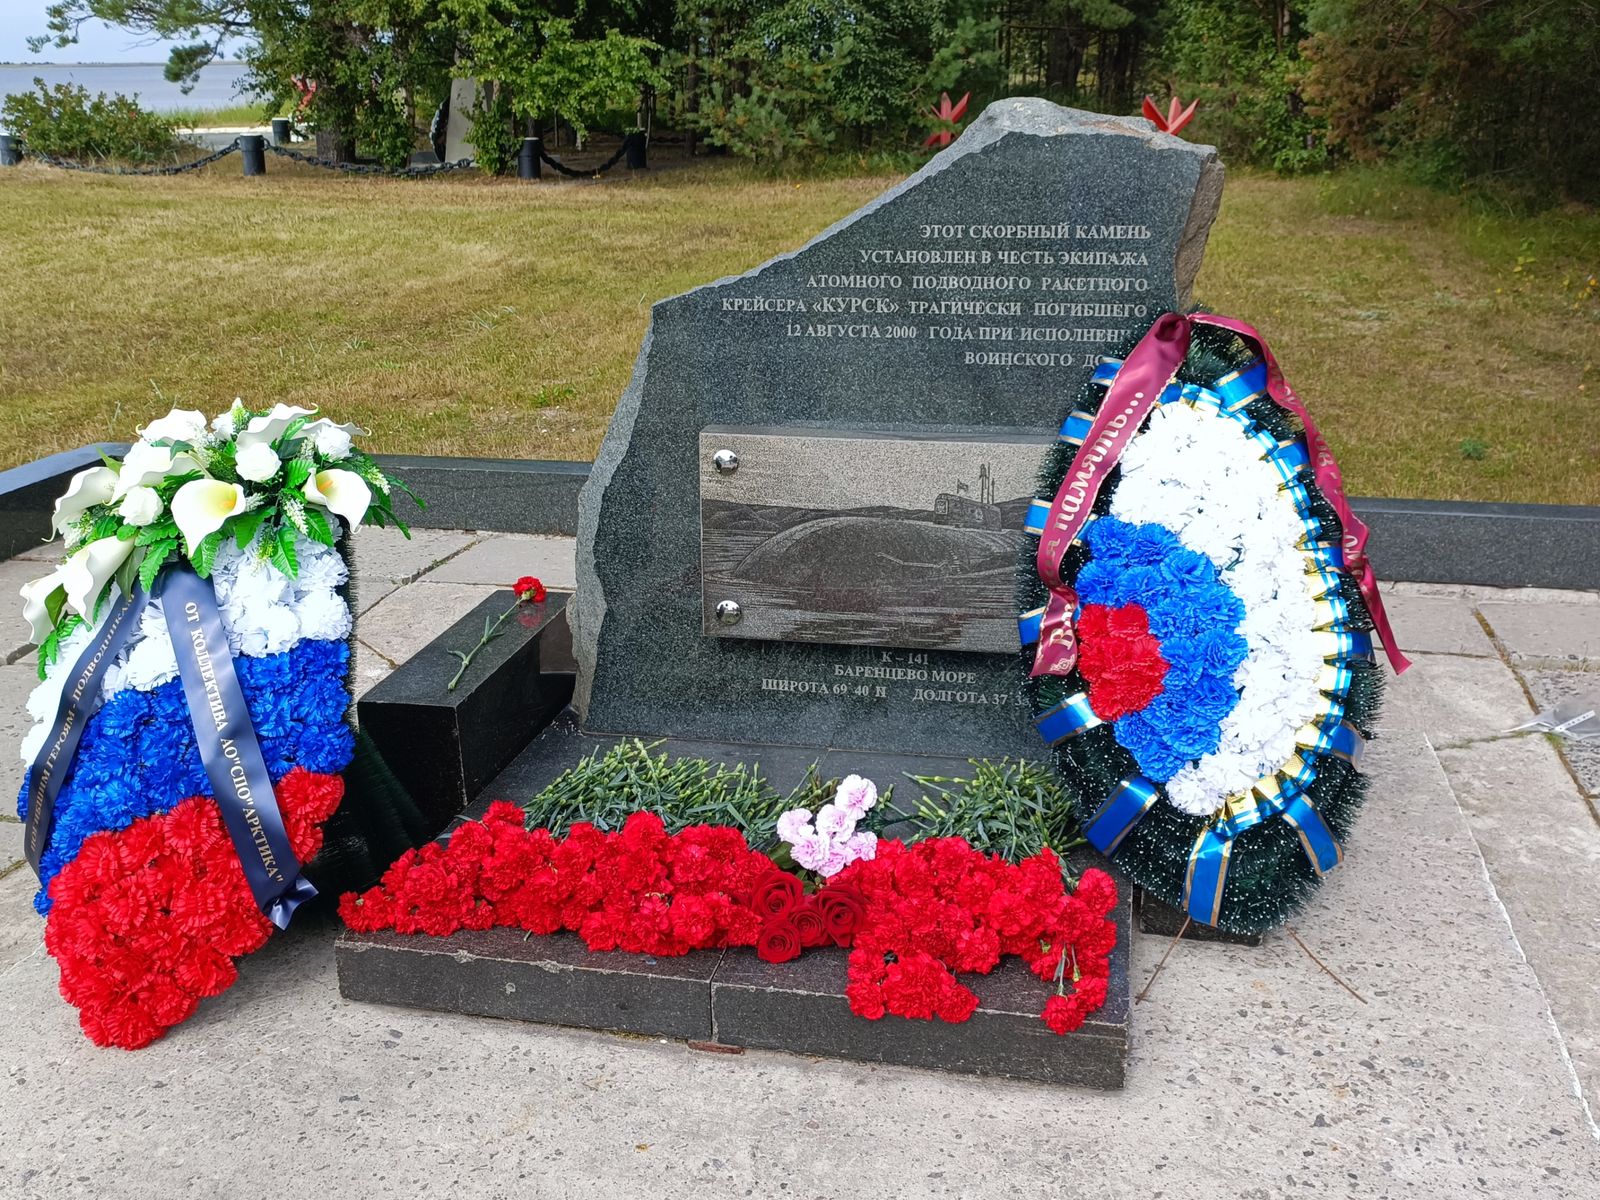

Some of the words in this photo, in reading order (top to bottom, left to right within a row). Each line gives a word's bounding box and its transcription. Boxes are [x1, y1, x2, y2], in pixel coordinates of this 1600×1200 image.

[920, 224, 965, 239] ЭТОТ
[969, 222, 1070, 239] СКОРБНЫЙ
[1075, 224, 1151, 239] КАМЕНЬ
[860, 250, 976, 264] УСТАНОВЛЕН
[980, 250, 992, 264] В
[998, 251, 1054, 265] ЧЕСТЬ
[1059, 251, 1149, 266] ЭКИПАЖА
[806, 274, 902, 289] АТОМНОГО
[912, 275, 1031, 291] ПОДВОДНОГО
[1041, 277, 1149, 292] РАКЕТНОГО
[721, 296, 807, 312] КРЕЙСЕРА
[812, 296, 900, 313] «КУРСК»
[908, 300, 1021, 315] ТРАГИЧЕСКИ
[1034, 302, 1147, 317] ПОГИБШЕГО
[787, 324, 801, 337] 12
[804, 324, 881, 338] АВГУСТА
[885, 325, 917, 339] 2000
[929, 326, 974, 341] ГОДА
[979, 327, 1014, 341] ПРИ
[965, 351, 1073, 366] ВОИНСКОГО
[184, 601, 200, 623] ОТ
[881, 652, 893, 664] К
[907, 653, 929, 665] 141
[190, 629, 229, 732] КОЛЛЕКТИВА
[834, 664, 929, 681] БАРЕНЦЕВО
[931, 669, 977, 684] МОРЕ
[761, 678, 829, 694] ШИРОТА
[912, 688, 988, 704] ДОЛГОТА
[29, 767, 50, 852] ПОГИБШИМ
[46, 710, 76, 769] ГЕРОЯМ
[72, 594, 135, 703] ПОДВОДНИКАМ
